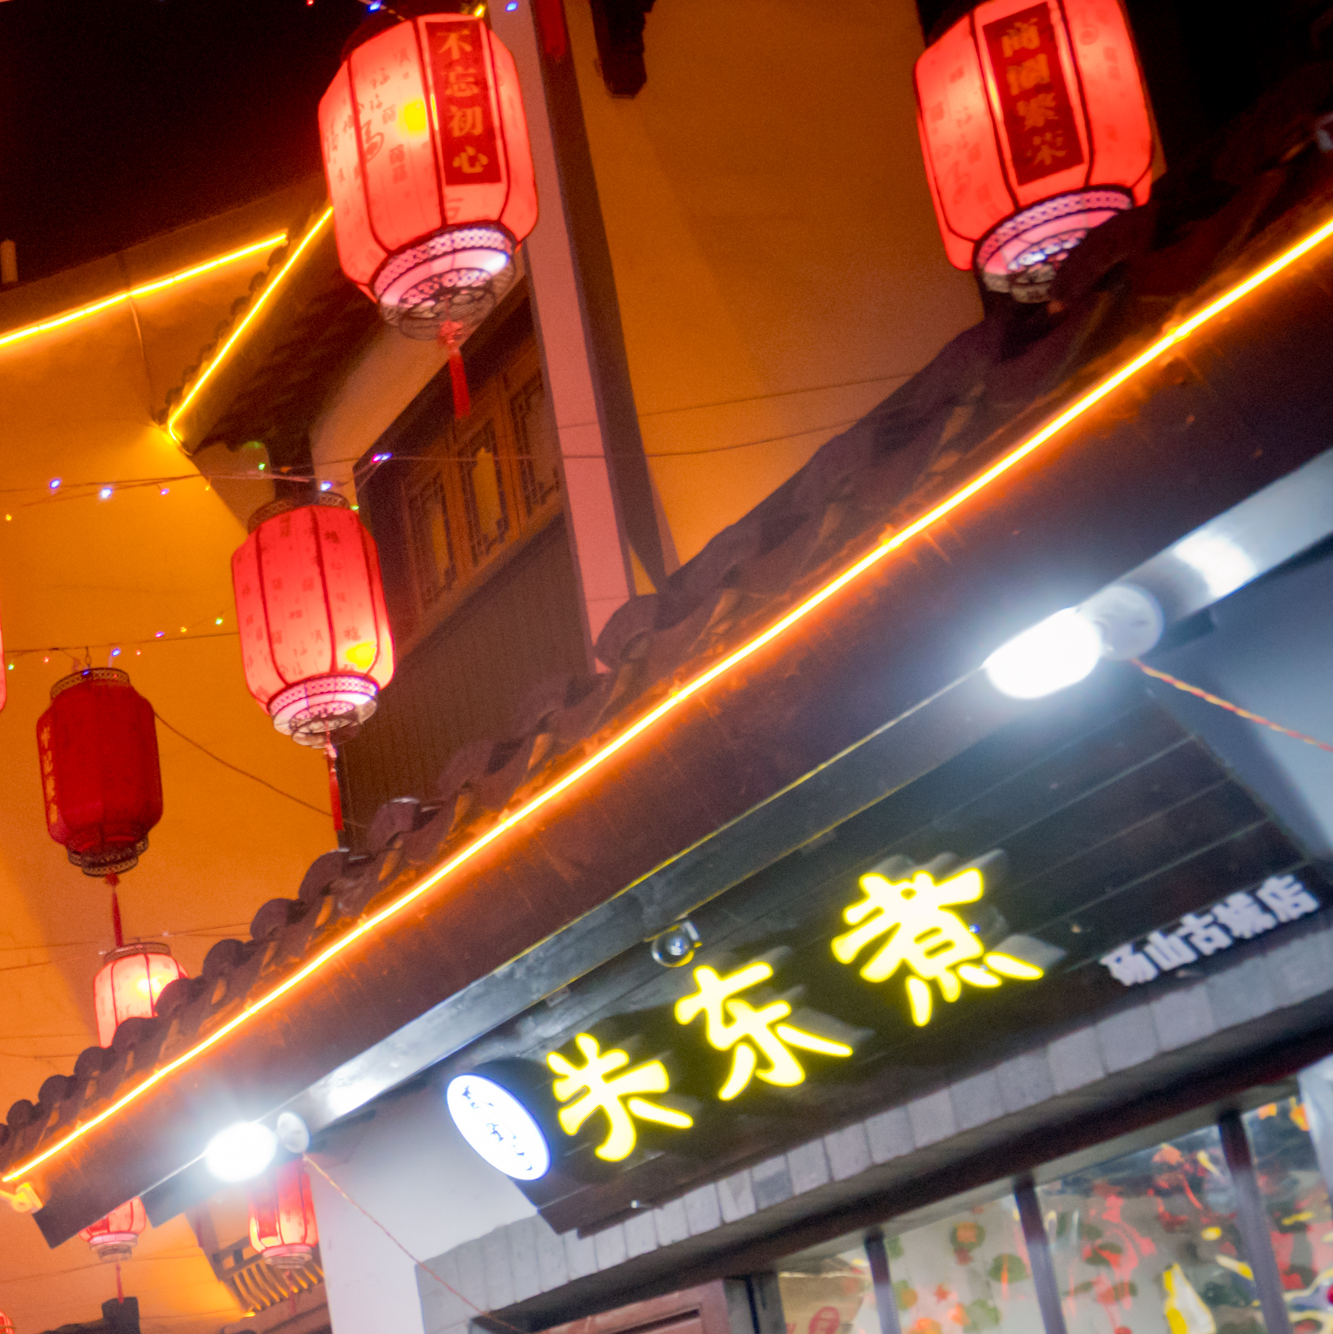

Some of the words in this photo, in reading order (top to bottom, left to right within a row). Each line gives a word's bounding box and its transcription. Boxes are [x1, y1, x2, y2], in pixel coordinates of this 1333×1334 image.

[437, 28, 489, 176] 不忘初心
[1001, 18, 1067, 165] 商圈繁荣
